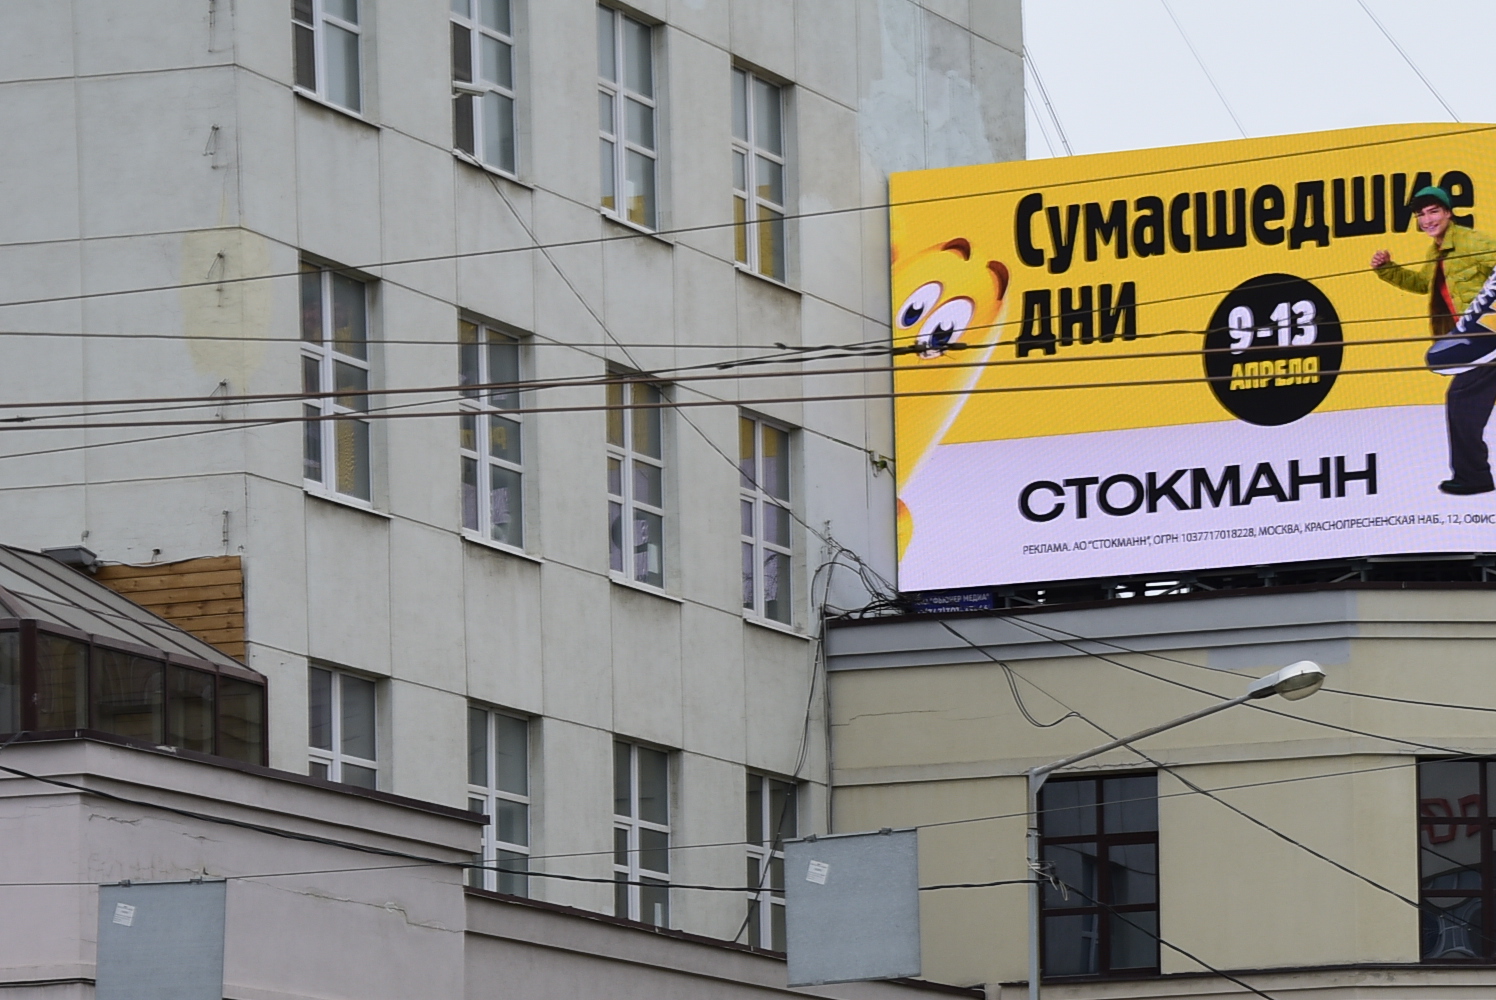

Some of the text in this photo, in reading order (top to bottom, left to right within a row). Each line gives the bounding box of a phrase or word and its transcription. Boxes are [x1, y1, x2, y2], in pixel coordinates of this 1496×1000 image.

[1015, 170, 1475, 273] Сумасшедшие
[1228, 300, 1318, 355] 9-13
[1229, 356, 1320, 391] АПРЕЛЯ
[1018, 452, 1377, 524] СТОКМАНН
[1022, 543, 1071, 555] РЕКЛАМА.
[1073, 540, 1087, 551] АО
[1153, 533, 1179, 545] ОГРН
[1258, 523, 1303, 537] МОСКВА,
[1304, 514, 1415, 533] КРАСНОПРЕСНЕНСКАЯ
[1447, 514, 1461, 525] 12,
[1464, 513, 1496, 525] ОФИС
